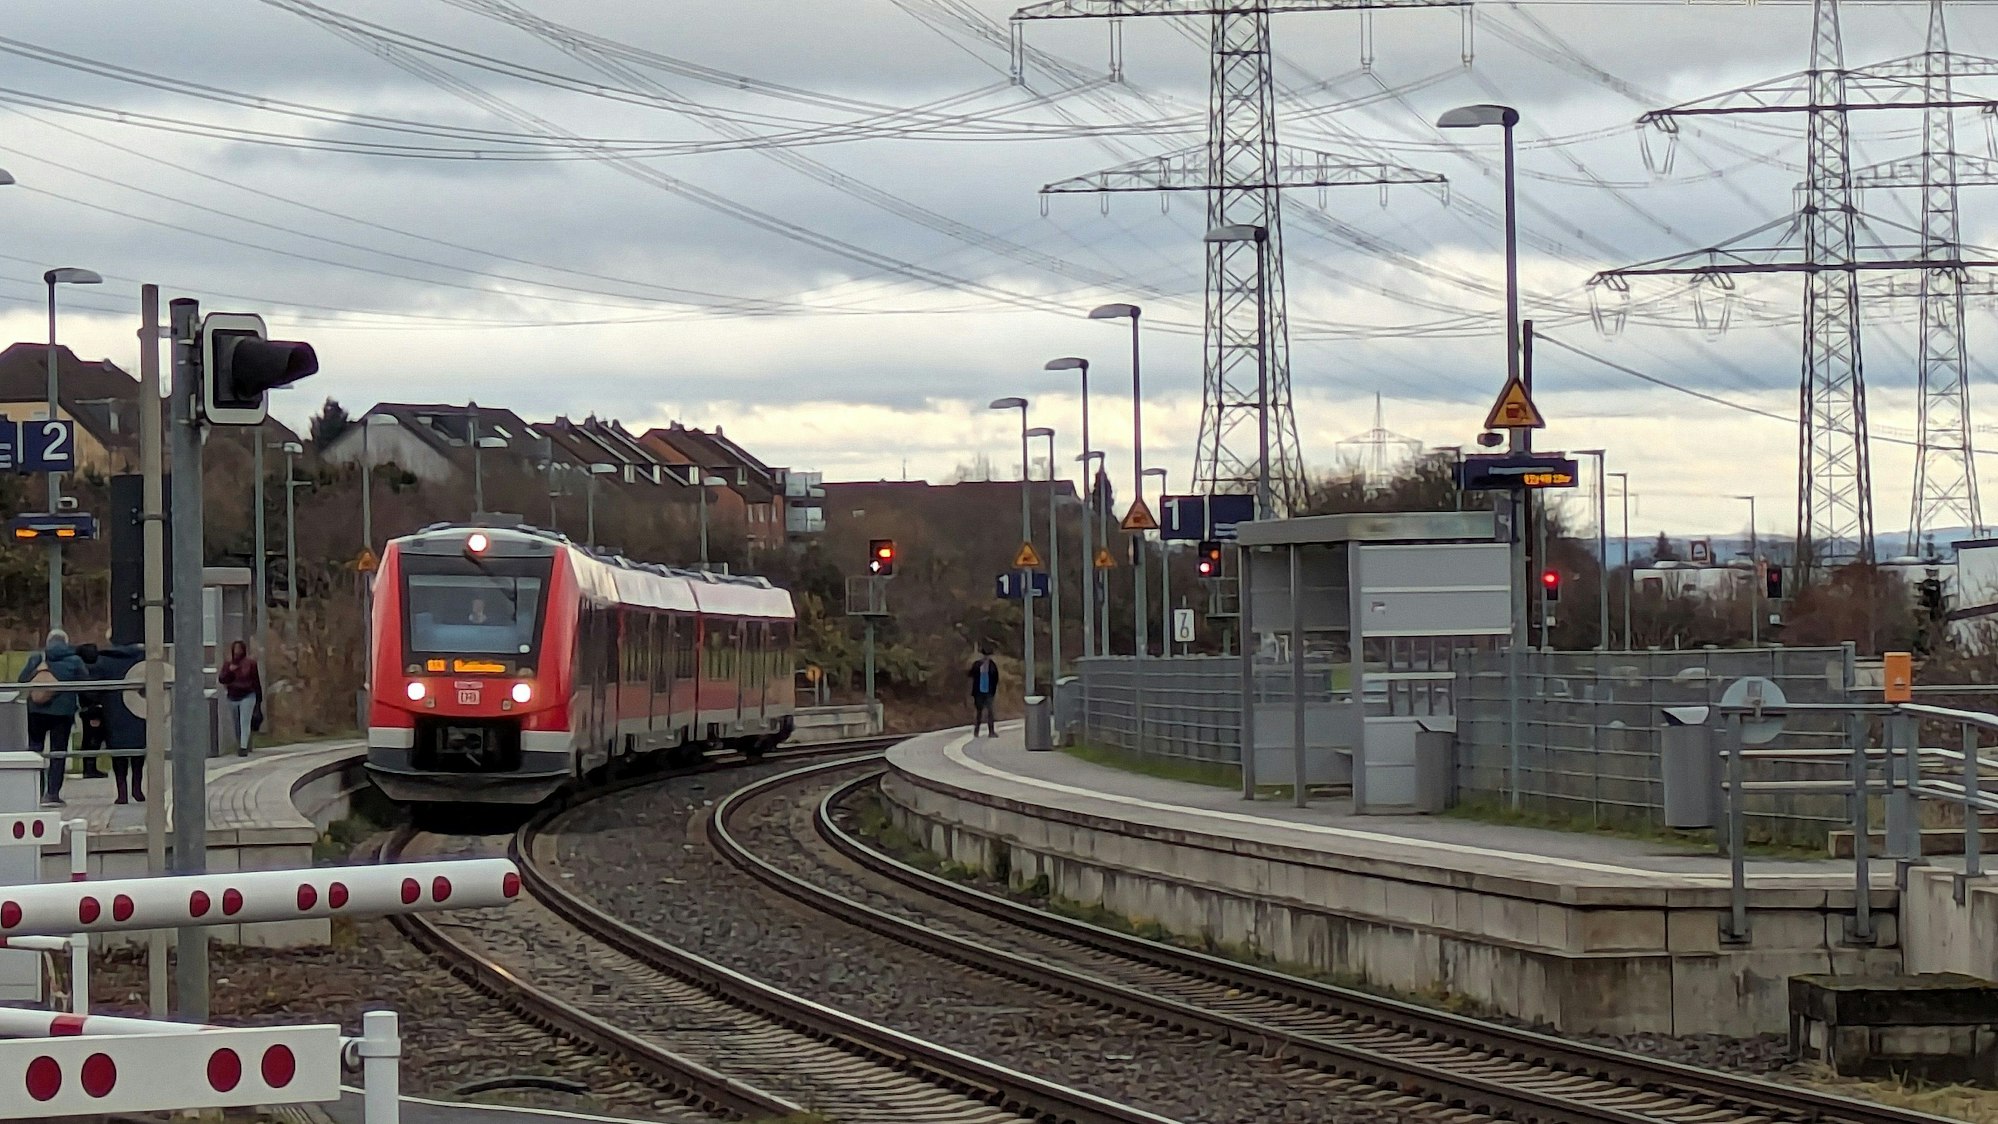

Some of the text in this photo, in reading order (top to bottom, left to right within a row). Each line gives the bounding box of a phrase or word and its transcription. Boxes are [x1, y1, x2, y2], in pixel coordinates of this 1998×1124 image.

[43, 422, 69, 461] 2
[1164, 499, 1179, 531] 1
[998, 574, 1009, 595] 1
[1180, 612, 1188, 626] 7
